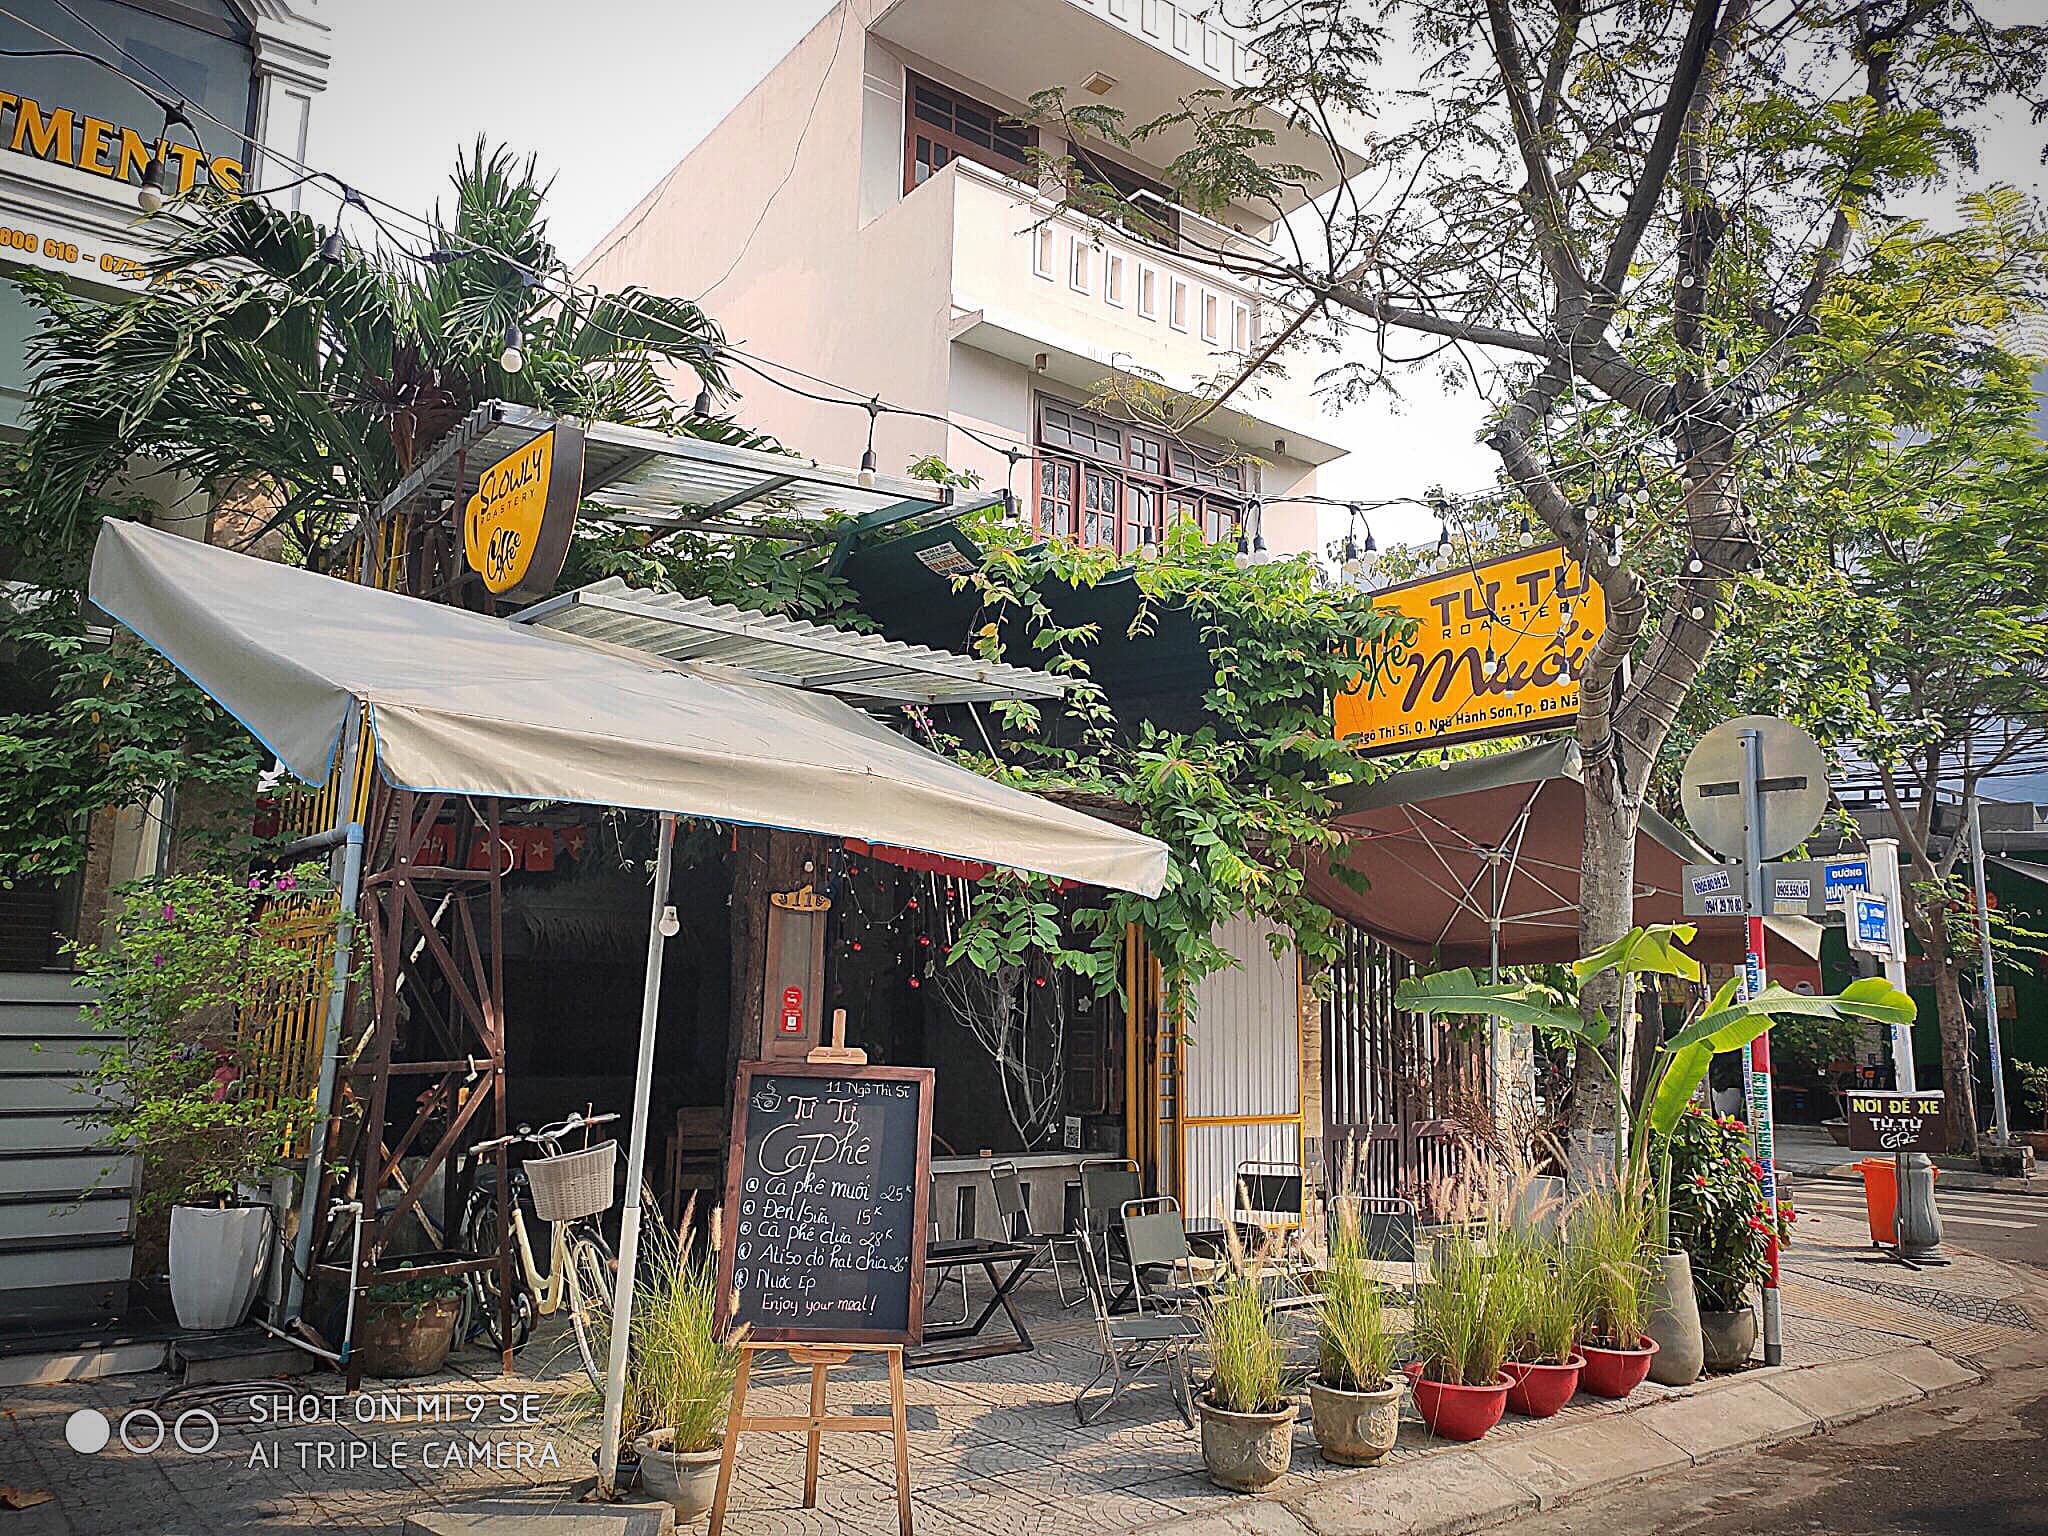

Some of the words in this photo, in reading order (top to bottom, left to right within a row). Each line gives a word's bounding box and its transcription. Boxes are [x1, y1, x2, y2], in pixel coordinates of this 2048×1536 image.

[480, 448, 543, 515] SLOWLY
[1414, 721, 1426, 734] Q.
[1540, 697, 1557, 712] Đà
[825, 1082, 843, 1094] 11
[1852, 1098, 1882, 1113] NƠI
[1918, 1100, 1940, 1115] XE
[790, 1172, 825, 1206] phê
[762, 1293, 799, 1317] Enjoy
[805, 1300, 834, 1317] your
